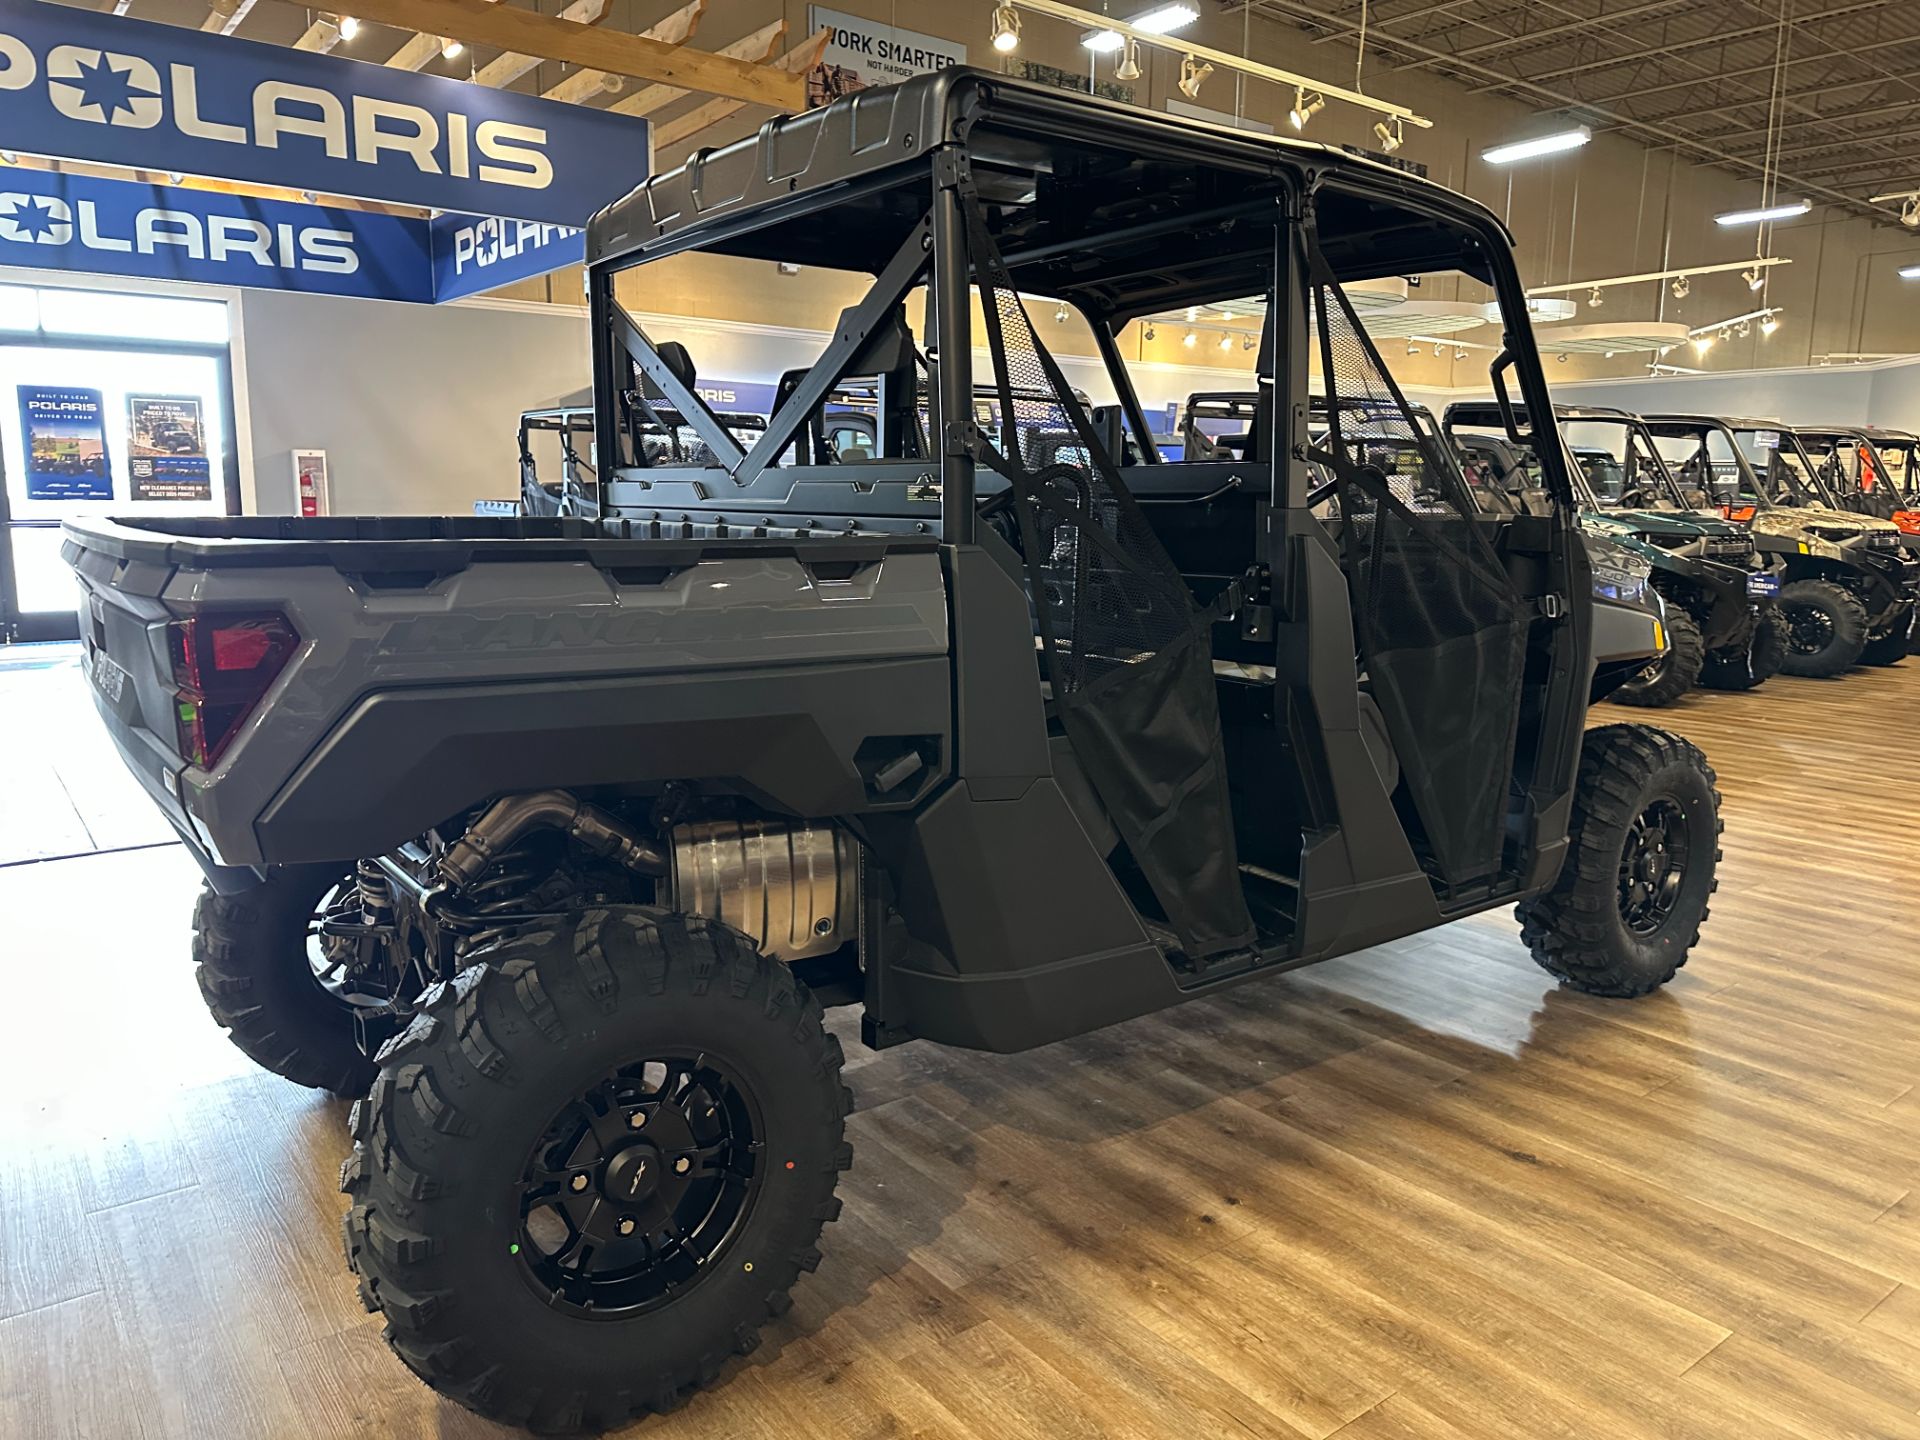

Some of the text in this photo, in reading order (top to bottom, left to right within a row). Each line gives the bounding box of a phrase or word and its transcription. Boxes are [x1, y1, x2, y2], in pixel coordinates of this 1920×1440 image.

[878, 40, 956, 71] SMARTER
[867, 59, 914, 77] NOT HARDER
[455, 217, 584, 275] POLA
[28, 401, 97, 411] POLARIS
